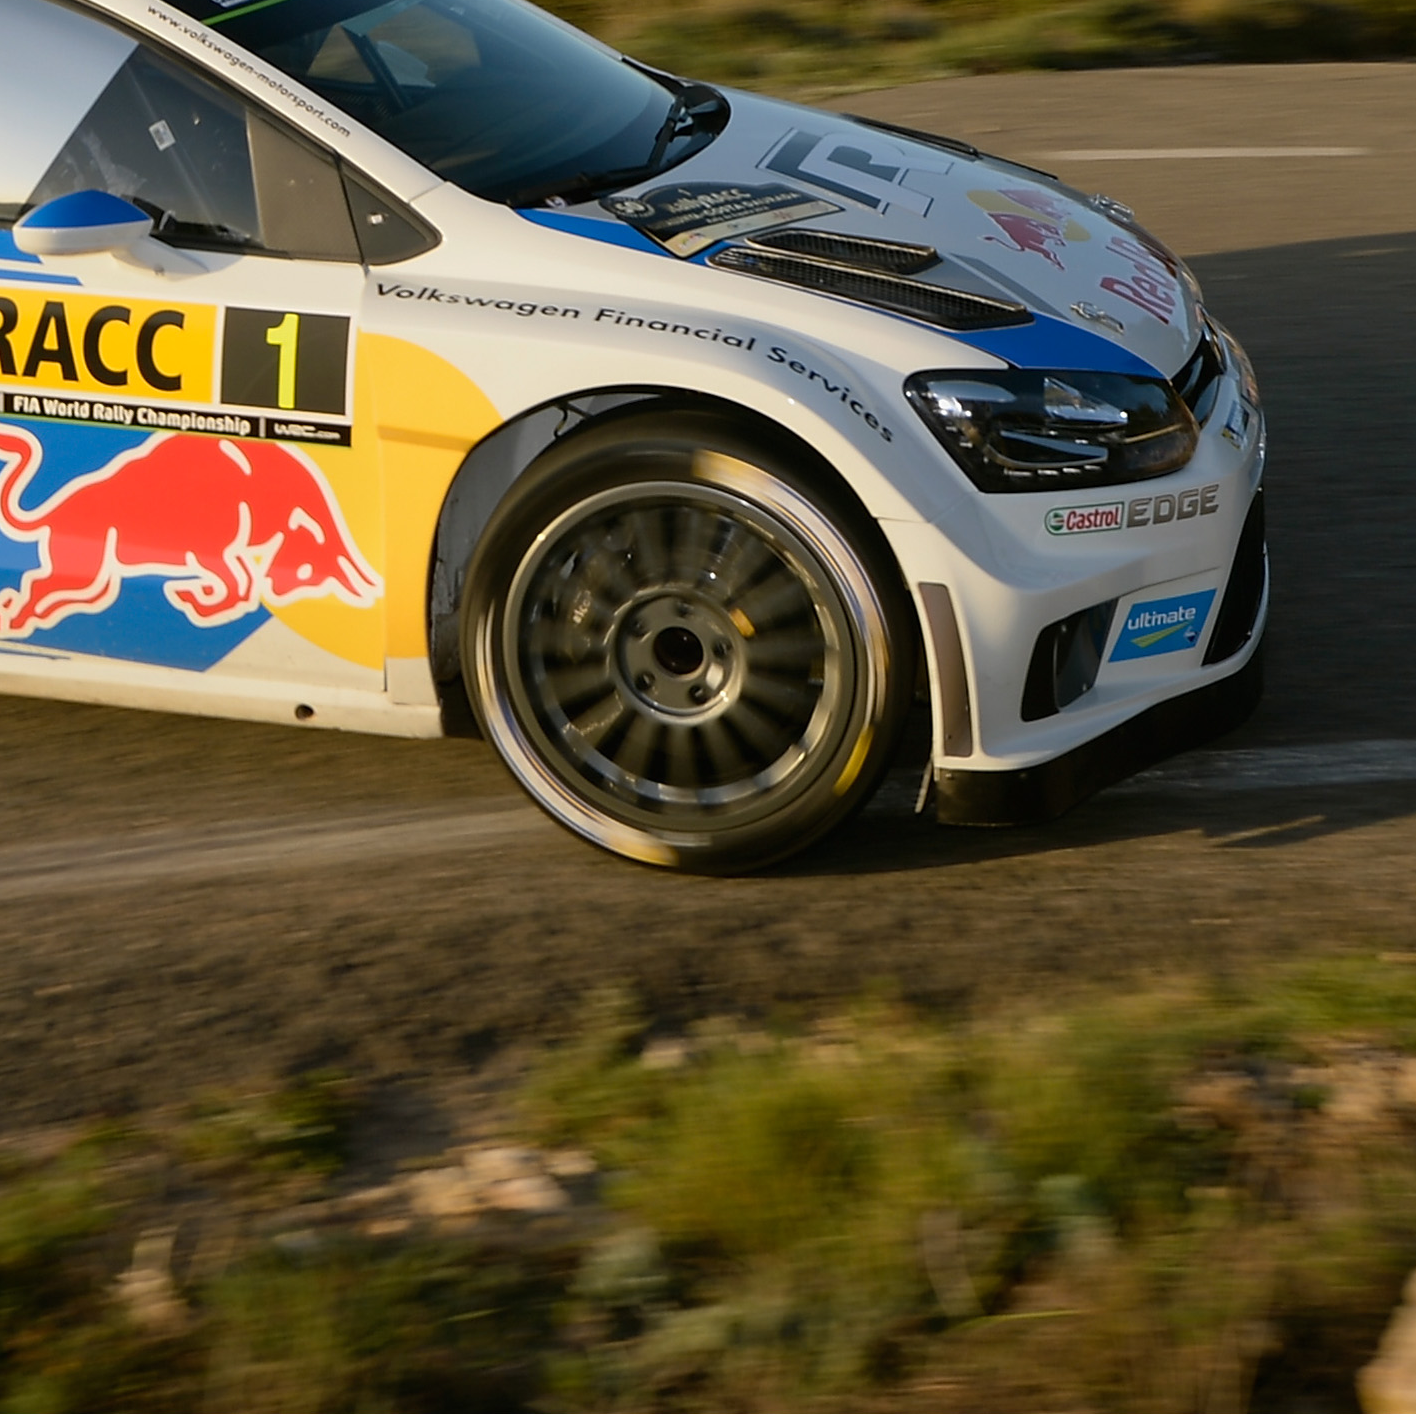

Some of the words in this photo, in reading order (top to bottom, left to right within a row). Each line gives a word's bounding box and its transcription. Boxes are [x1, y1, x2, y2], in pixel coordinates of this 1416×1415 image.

[147, 5, 351, 138] www.volkswagen-motorsport.com
[266, 313, 300, 409] 1
[375, 283, 583, 319] Volkswagen
[593, 308, 757, 352] Financial
[766, 346, 894, 445] Services
[13, 395, 41, 414] FIA
[42, 398, 89, 419] World
[93, 402, 135, 425] Rally
[136, 407, 252, 436] Championship
[1066, 506, 1120, 531] Castrol
[1126, 484, 1220, 528] EDGE
[1127, 606, 1197, 631] ultimate
